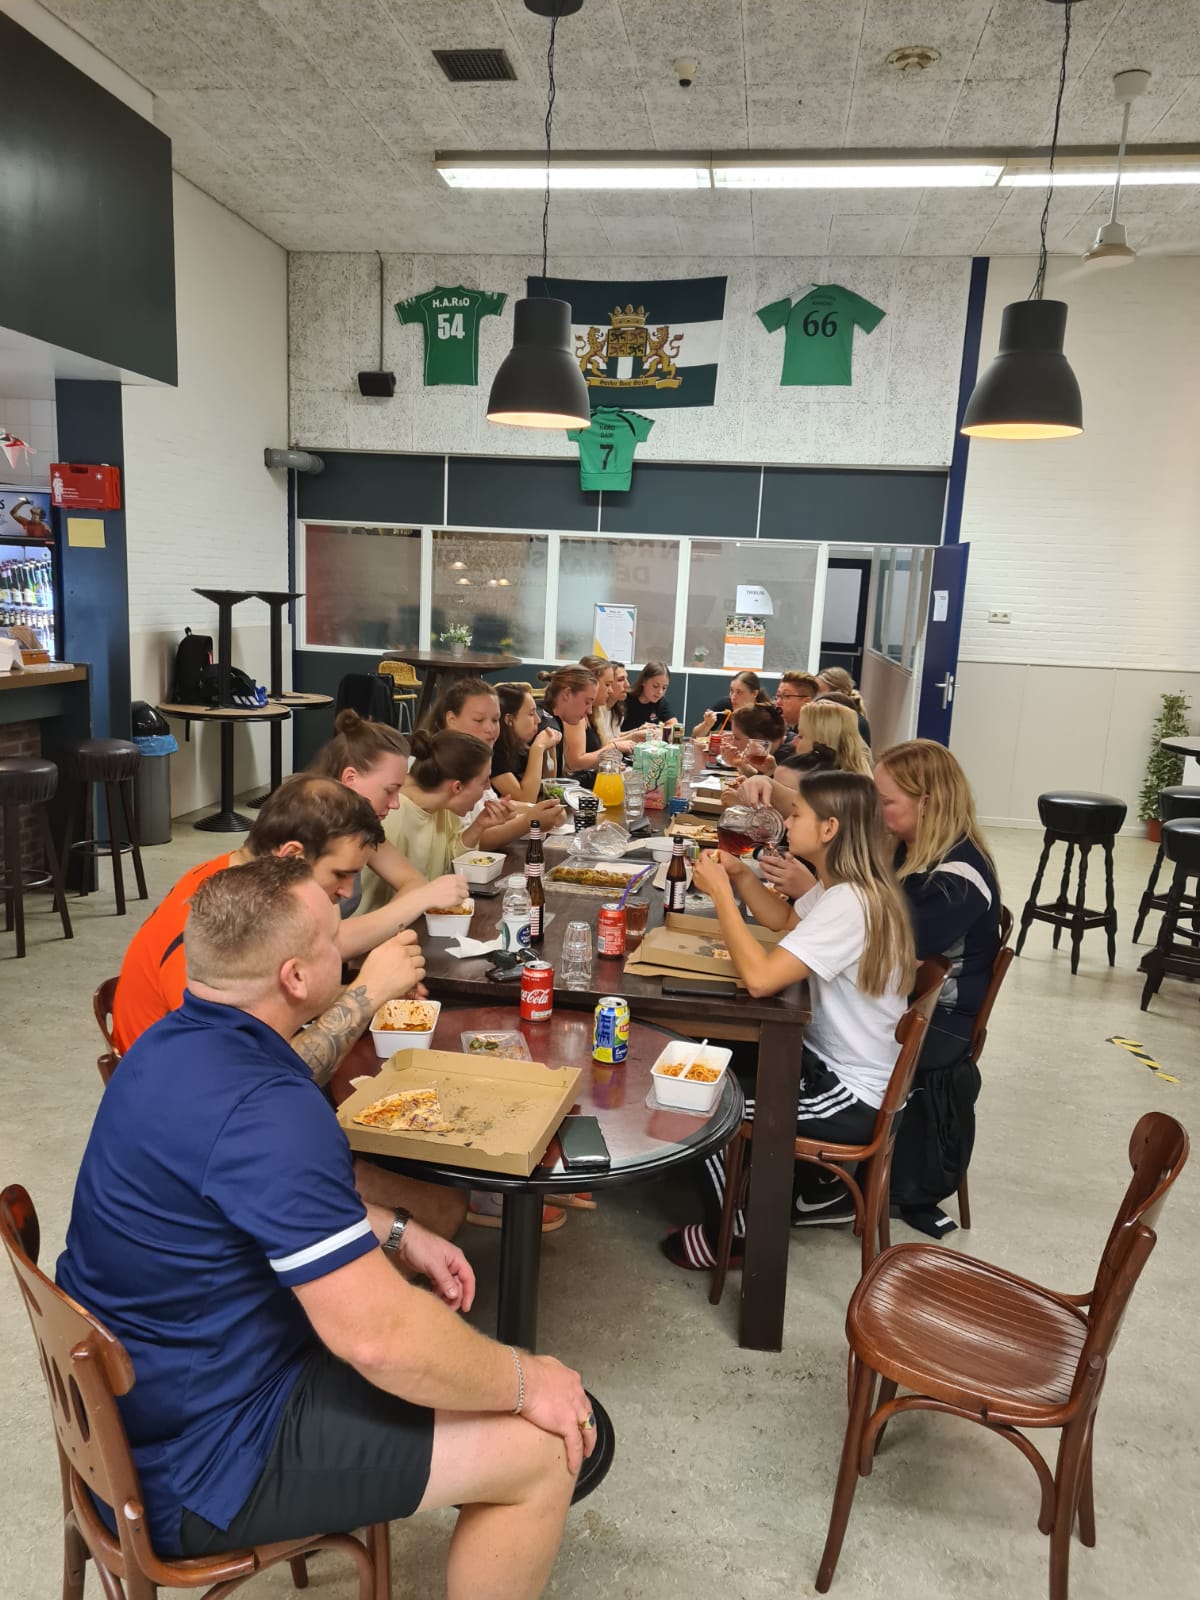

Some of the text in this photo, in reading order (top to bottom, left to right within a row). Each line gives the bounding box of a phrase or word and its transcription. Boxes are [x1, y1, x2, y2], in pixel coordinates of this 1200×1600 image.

[437, 313, 466, 340] 54
[803, 310, 839, 338] 66
[600, 444, 614, 470] 7
